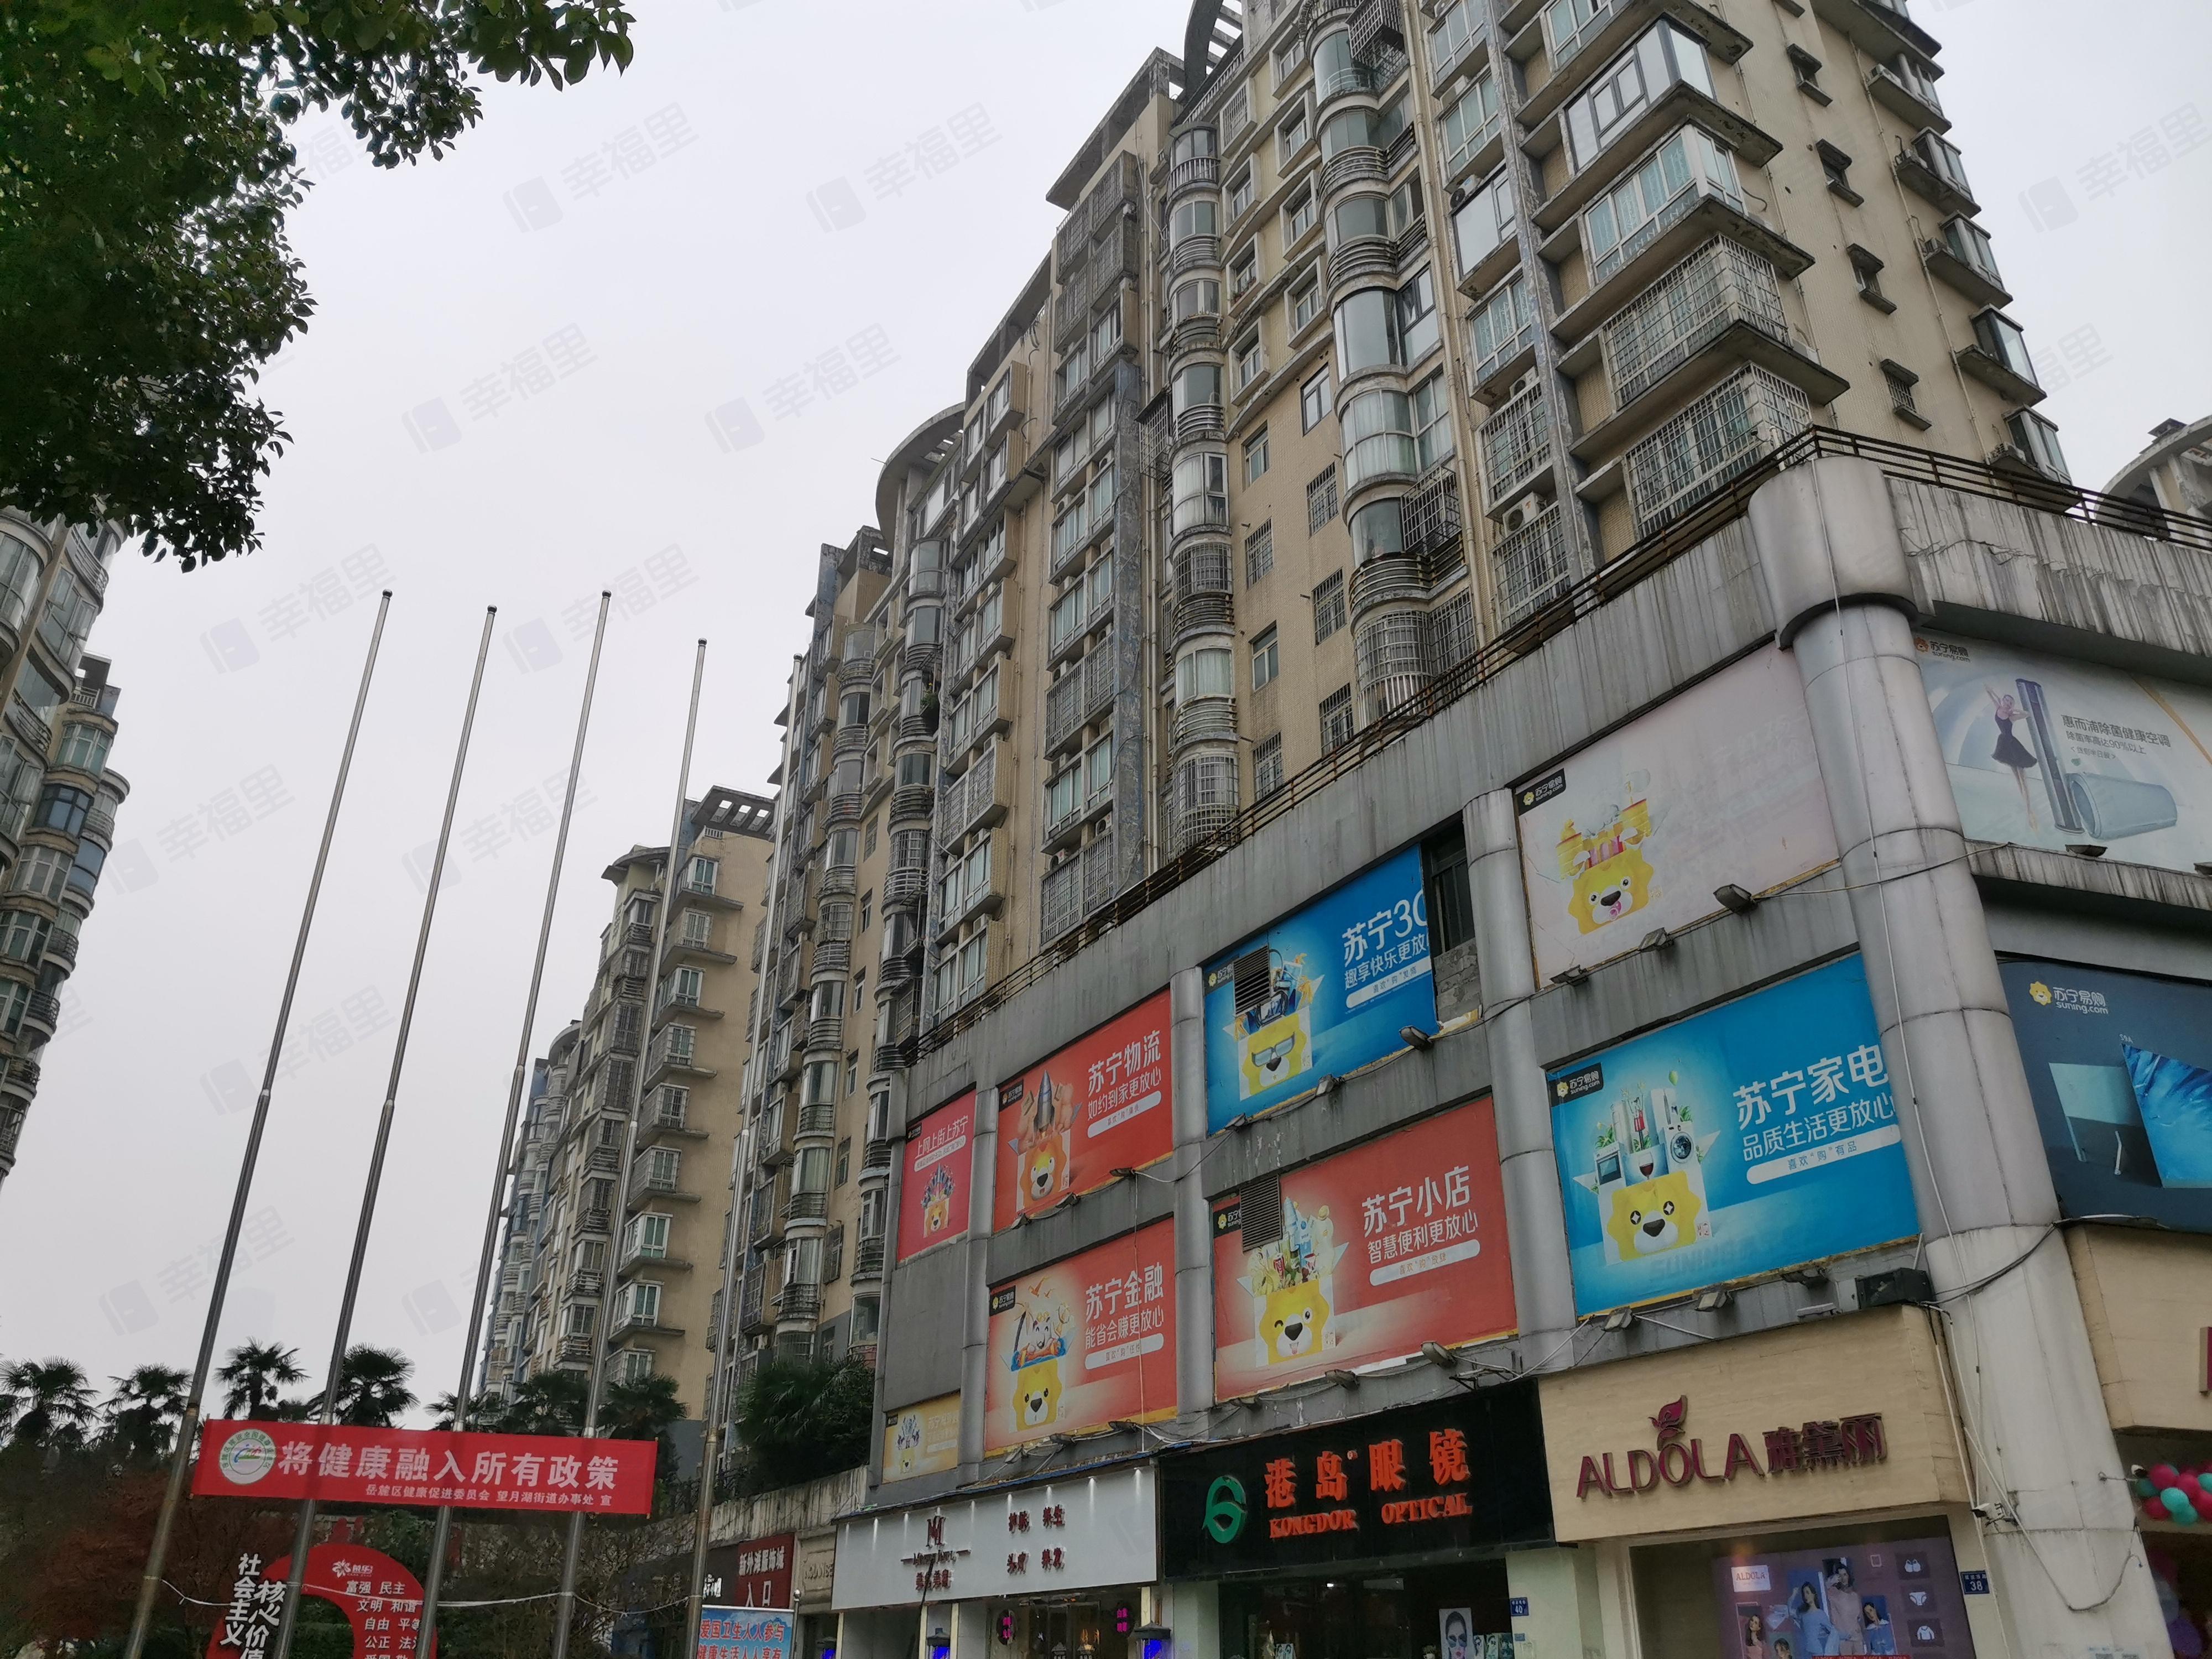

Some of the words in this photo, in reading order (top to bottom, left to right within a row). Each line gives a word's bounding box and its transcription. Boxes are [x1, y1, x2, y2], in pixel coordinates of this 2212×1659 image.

[2060, 714, 2171, 748] 惠而浦除菌健康空调
[1344, 933, 1430, 990] 趣享快乐更放
[2053, 987, 2106, 1007] 苏宁易购
[2056, 1001, 2109, 1014] suning.com
[1088, 1030, 1161, 1097] 苏宁物流
[1569, 1071, 1599, 1089] 苏宁易购
[1088, 1066, 1161, 1121] 如约到家更放心
[1570, 1080, 1600, 1094] suning.com
[1733, 1044, 1889, 1131] 苏宁家电
[914, 1115, 968, 1160] 上网上街上苏宁
[1743, 1092, 1896, 1162] 品质生活更放心
[1361, 1165, 1470, 1238] 苏宁小店
[1368, 1209, 1479, 1265] 智慧便利更放心
[1086, 1262, 1164, 1323] 苏宁金融
[1086, 1305, 1164, 1350] 能省会赚更放心
[278, 1441, 619, 1490] 将健康融入所有政策
[1264, 1428, 1471, 1509] 港岛眼镜
[1576, 1433, 1767, 1500] ALDOLA
[365, 1484, 490, 1501] 岳麓区健康促进委员会
[497, 1490, 594, 1506] 望月湖街道办事处
[600, 1494, 612, 1506] 宣
[1381, 1493, 1473, 1525] OPTICAL
[220, 1553, 262, 1647] 社会主义
[345, 1580, 372, 1594] 富强
[379, 1581, 406, 1595] 民主
[745, 1579, 772, 1607] 入口
[1969, 1580, 1983, 1592] 38
[239, 1580, 288, 1659] 核心价值
[356, 1599, 383, 1613] 文明
[390, 1599, 418, 1614] 和谐
[364, 1618, 390, 1632] 自由
[1515, 1605, 1524, 1614] 40
[364, 1635, 391, 1650] 公正
[700, 1619, 785, 1642] 爱国卫生人人参与
